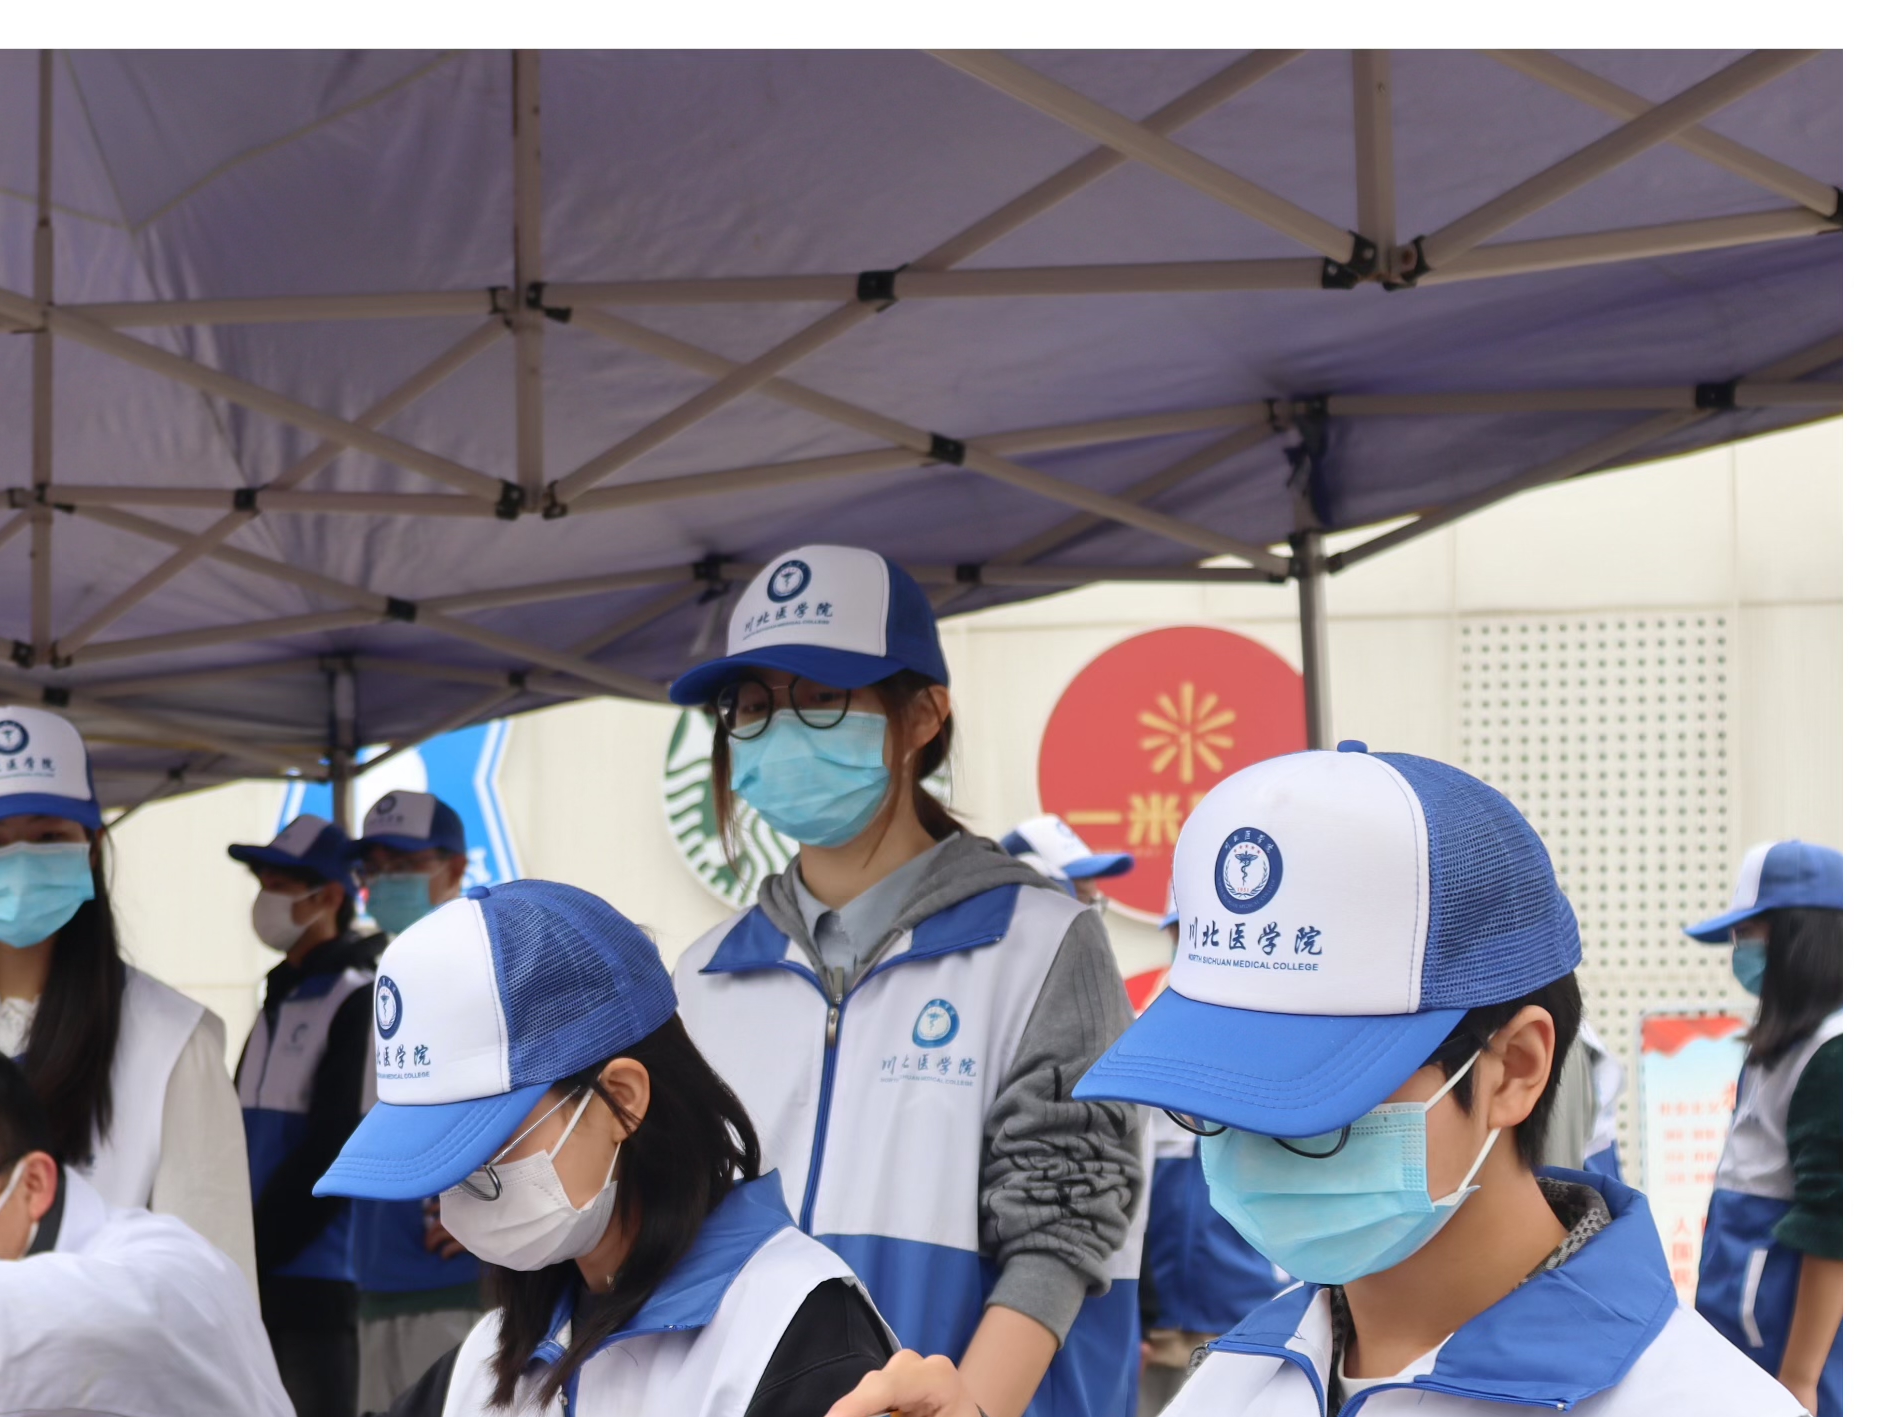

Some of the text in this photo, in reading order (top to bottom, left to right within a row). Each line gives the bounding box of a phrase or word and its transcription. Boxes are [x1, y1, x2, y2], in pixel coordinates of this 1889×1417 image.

[744, 602, 833, 633] 川北医学院
[1188, 916, 1323, 956] 川北医学院
[1202, 956, 1232, 967] SICHUAN
[1232, 959, 1271, 970] MEDICAL
[1272, 962, 1319, 971] COLLEGE
